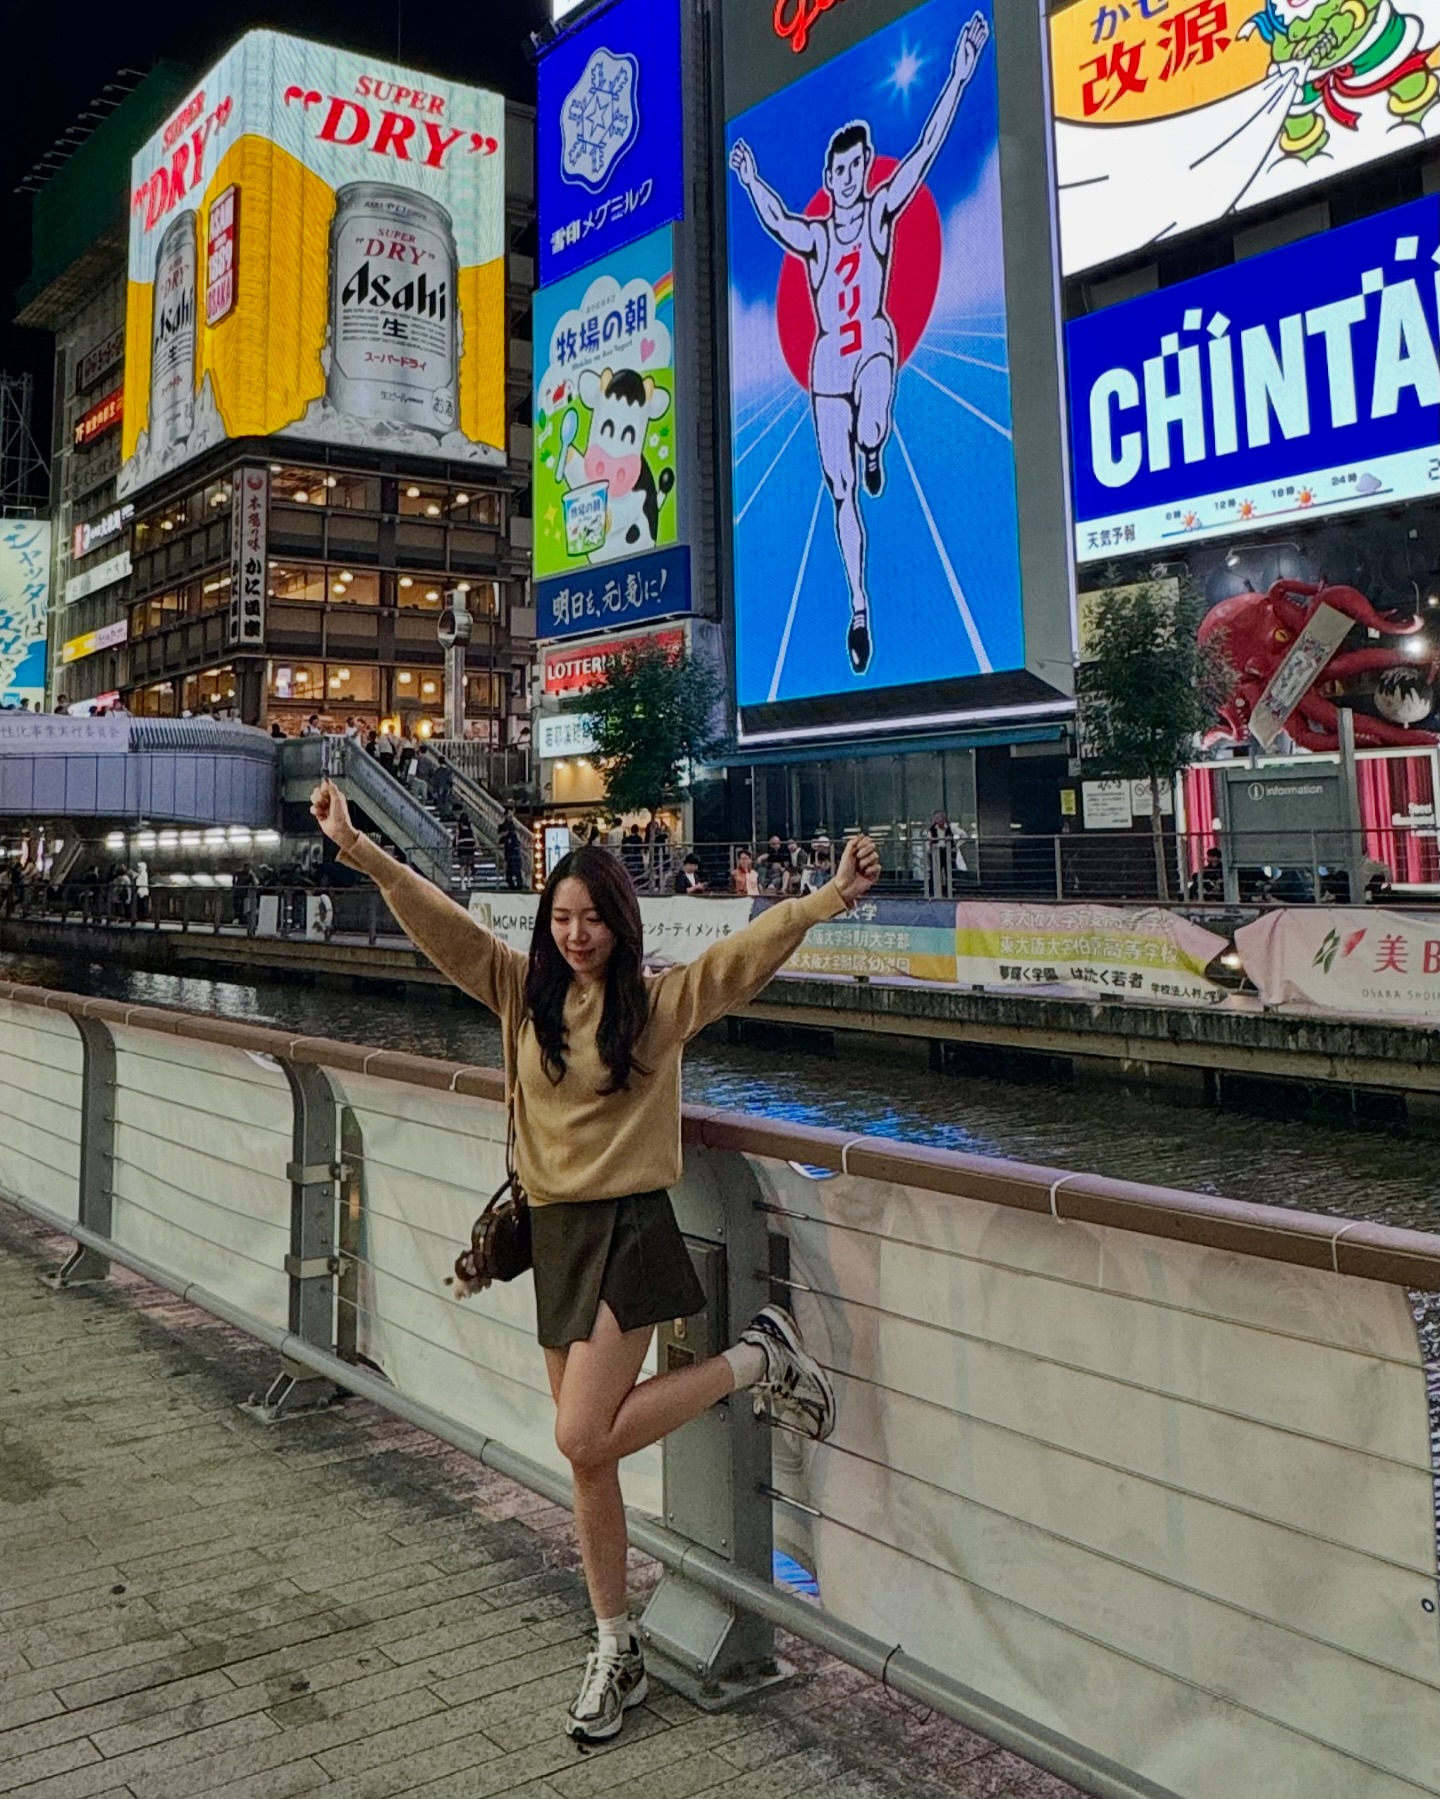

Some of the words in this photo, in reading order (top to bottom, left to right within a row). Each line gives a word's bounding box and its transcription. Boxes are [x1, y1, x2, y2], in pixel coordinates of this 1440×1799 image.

[1079, 0, 1231, 117] 改源
[355, 75, 446, 117] SUPER
[550, 178, 652, 255] 雪印メグミルク
[377, 228, 416, 243] SUPER
[341, 260, 447, 321] Asahi
[834, 242, 862, 357] グリコ
[382, 317, 409, 340] 生
[557, 293, 647, 367] 牧場の朝
[364, 351, 427, 372] スーパードライ
[1089, 236, 1440, 487] CHINTA
[1331, 472, 1358, 486] 24時
[1087, 524, 1136, 550] 天気予報
[1265, 783, 1324, 796] information
[493, 915, 517, 930] MGM
[1373, 934, 1409, 974] 美
[1361, 988, 1401, 999] OSAKA
